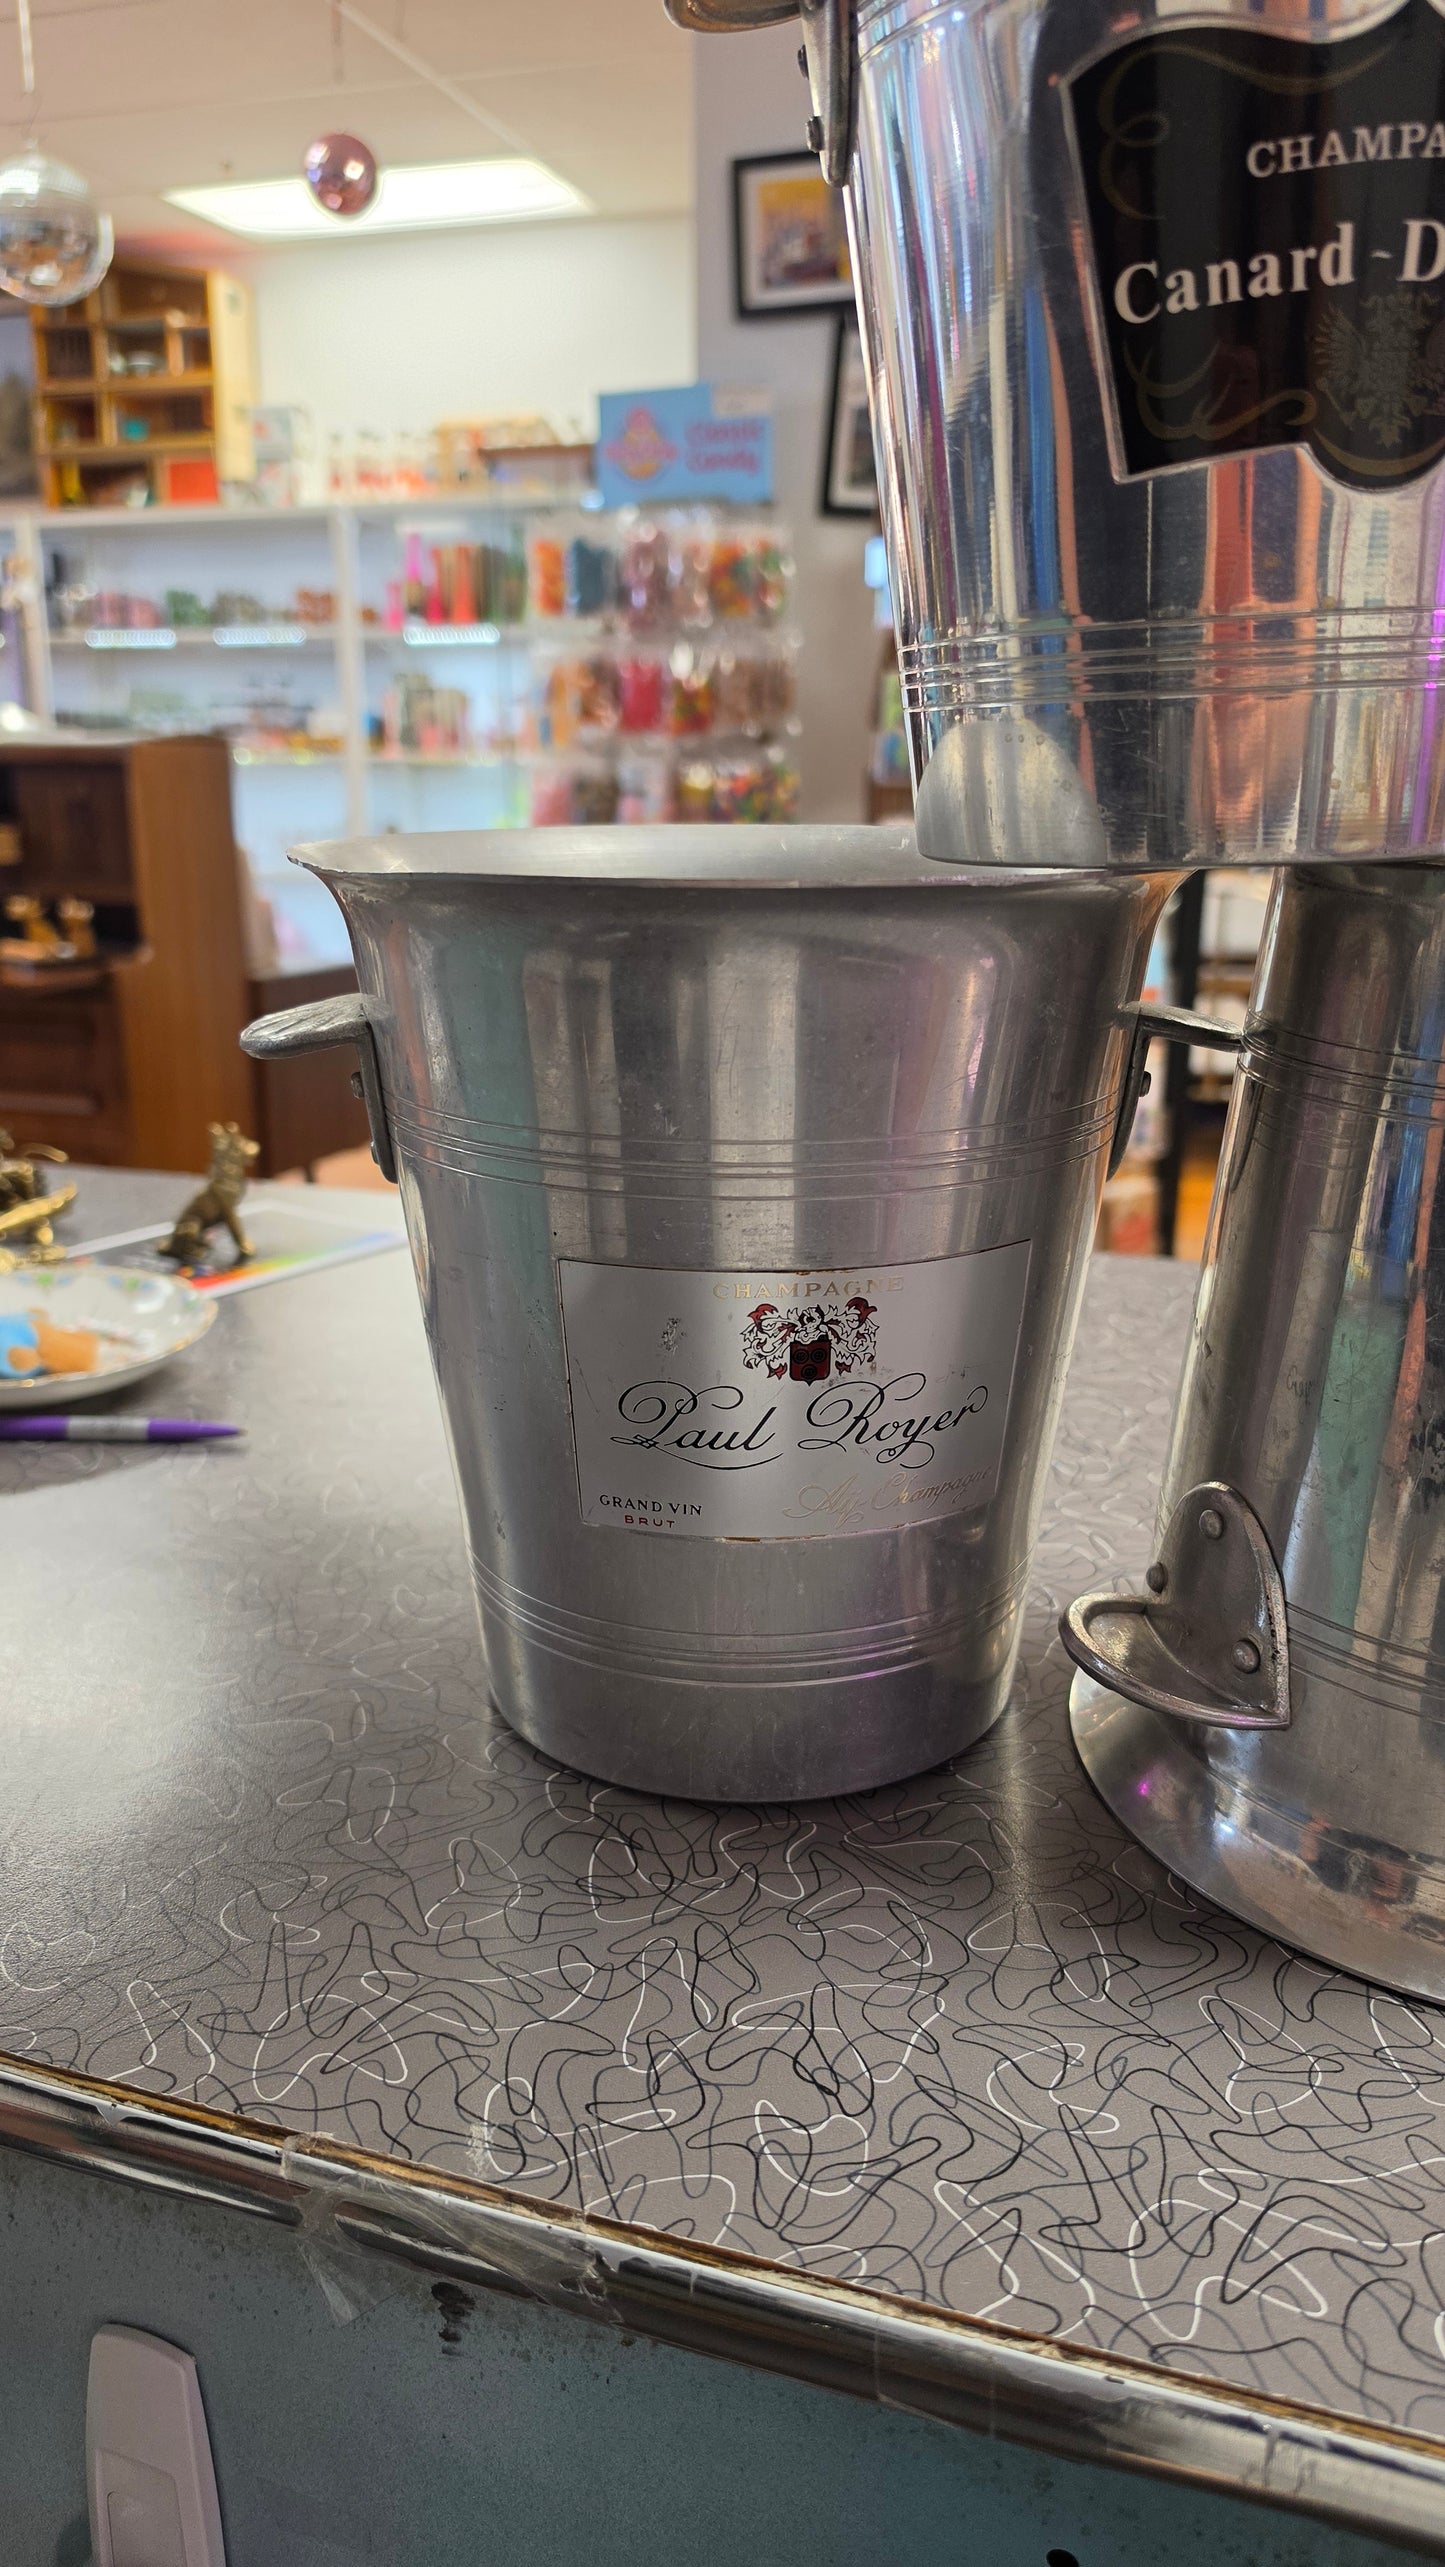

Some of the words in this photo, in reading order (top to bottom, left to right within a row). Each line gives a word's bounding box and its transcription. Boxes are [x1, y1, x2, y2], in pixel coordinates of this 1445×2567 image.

[1246, 121, 1445, 178] CHAMPA
[713, 1276, 905, 1300] CHAMPAGNE
[610, 1380, 784, 1470] Paul
[798, 1372, 988, 1469] Royer
[600, 1494, 662, 1512] GRAND
[668, 1502, 702, 1516] VIN
[624, 1514, 675, 1529] BRUT
